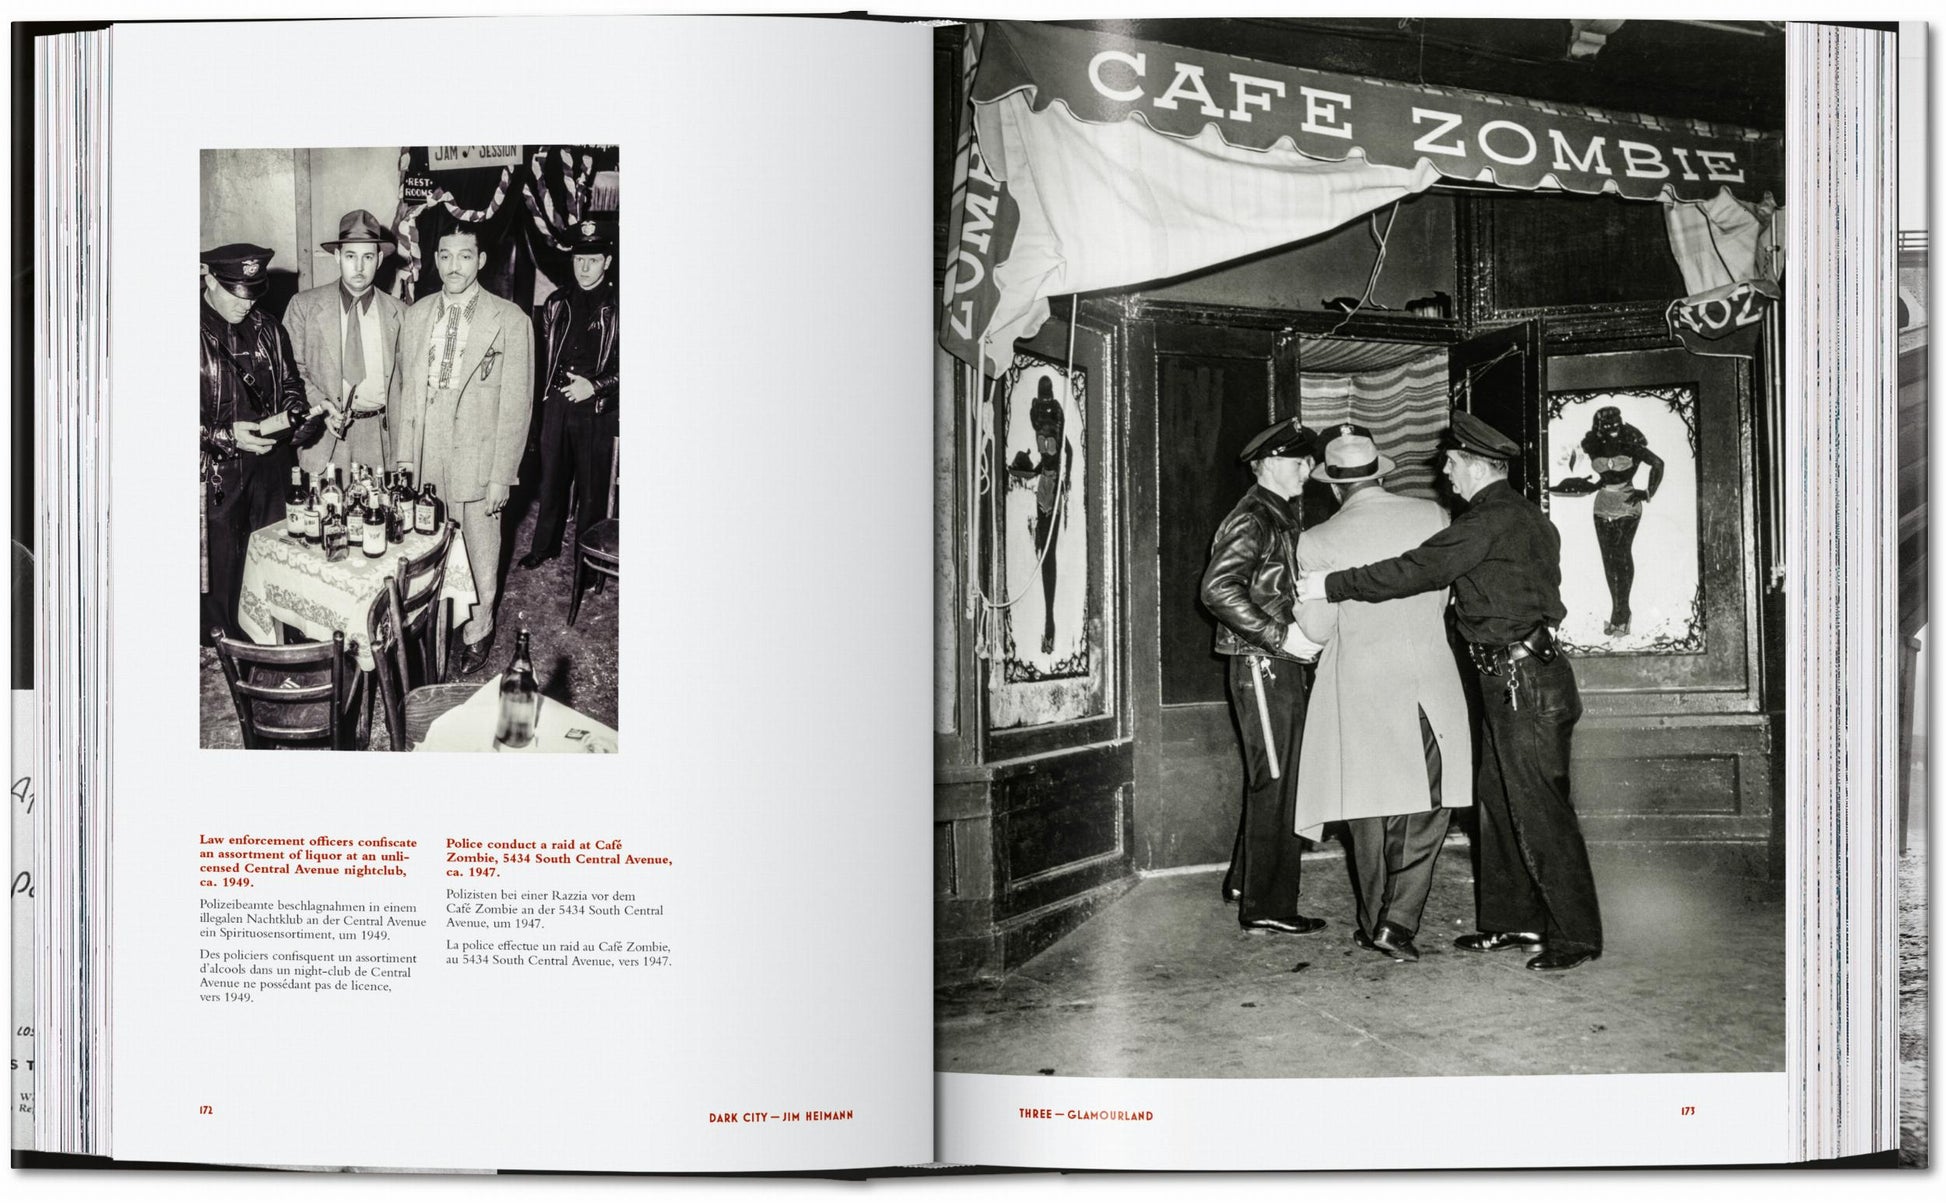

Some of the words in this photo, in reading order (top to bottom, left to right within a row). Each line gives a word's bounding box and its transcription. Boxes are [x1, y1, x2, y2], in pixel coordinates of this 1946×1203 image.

[1088, 49, 1352, 140] CAFE
[1411, 106, 1746, 183] ZOMBIE
[435, 146, 458, 161] JAM
[405, 188, 433, 197] ROOMS
[199, 833, 225, 845] Law
[228, 833, 306, 847] enforcement
[308, 834, 354, 848] officers
[357, 835, 418, 848] confiscate
[445, 837, 484, 850] Police
[486, 837, 538, 850] conduct
[539, 841, 548, 850] a
[551, 838, 576, 851] raid
[578, 840, 592, 851] at
[594, 838, 623, 851] Café
[199, 850, 215, 859] an
[217, 849, 286, 860] assortment
[288, 848, 304, 861] of
[304, 848, 343, 864] liquor
[345, 852, 359, 861] at
[361, 853, 377, 862] an
[380, 850, 411, 862] unli-
[446, 851, 499, 866] Zombie,
[502, 852, 532, 864] 5434
[534, 852, 572, 865] South
[575, 853, 621, 865] Central
[624, 853, 673, 867] Avenue,
[199, 862, 241, 873] censed
[243, 862, 291, 875] Central
[293, 863, 340, 875] Avenue
[343, 864, 407, 879] nightclub,
[445, 869, 464, 878] ca.
[468, 866, 501, 878] 1947.
[199, 879, 218, 888] ca.
[222, 876, 255, 888] 1949.
[446, 887, 498, 900] Polizisten
[500, 888, 518, 901] bei
[520, 889, 549, 901] einer
[551, 890, 588, 901] Razzia
[590, 893, 610, 902] vor
[611, 890, 636, 902] dem
[199, 898, 275, 911] Polizeibeamte
[277, 899, 366, 917] beschlagnahmen
[368, 901, 380, 913] in
[383, 901, 417, 913] einem
[445, 902, 472, 914] Café
[474, 903, 519, 915] Zombie
[521, 907, 535, 915] an
[537, 903, 556, 916] der
[558, 904, 586, 916] 5434
[588, 904, 621, 916] South
[623, 904, 664, 916] Central
[199, 911, 243, 927] illegalen
[246, 913, 304, 925] Nachtklub
[306, 917, 319, 926] an
[322, 914, 341, 926] der
[343, 915, 384, 927] Central
[386, 915, 427, 928] Avenue
[445, 916, 490, 929] Avenue,
[493, 920, 511, 929] um
[515, 918, 545, 929] 1947.
[199, 926, 217, 938] ein
[219, 927, 336, 941] Spirituosensortiment,
[338, 932, 357, 941] um
[362, 929, 391, 941] 1949.
[446, 938, 460, 950] La
[462, 938, 495, 953] police
[497, 939, 540, 952] effectue
[542, 943, 557, 952] un
[559, 940, 580, 952] raid
[582, 943, 595, 952] au
[598, 940, 623, 953] Café
[626, 940, 671, 954] Zombie,
[199, 948, 221, 960] Des
[223, 948, 269, 963] policiers
[271, 950, 335, 965] confisquent
[338, 954, 353, 963] un
[355, 952, 417, 964] assortiment
[445, 956, 459, 965] au
[462, 953, 490, 965] 5434
[492, 954, 525, 966] South
[527, 954, 569, 966] Central
[571, 955, 615, 968] Avenue,
[618, 958, 640, 967] vers
[643, 955, 672, 967] 1947.
[249, 963, 274, 975] dans
[276, 967, 291, 976] un
[293, 962, 352, 979] night-club
[354, 965, 368, 977] de
[370, 966, 412, 978] Central
[199, 977, 240, 989] Avenue
[243, 981, 257, 989] ne
[259, 976, 312, 992] possédant
[314, 982, 332, 993] pas
[334, 979, 349, 991] de
[351, 979, 392, 993] licence,
[199, 994, 221, 1002] vers
[225, 991, 254, 1003] 1949.
[199, 1105, 213, 1115] 172
[709, 1112, 738, 1124] DARK
[742, 1112, 768, 1123] CITY
[782, 1112, 800, 1122] JIM
[805, 1109, 854, 1121] HEIMANN
[1019, 1108, 1053, 1119] THREE
[1067, 1109, 1153, 1121] GLAMOURLAND
[1681, 1106, 1695, 1116] 173
